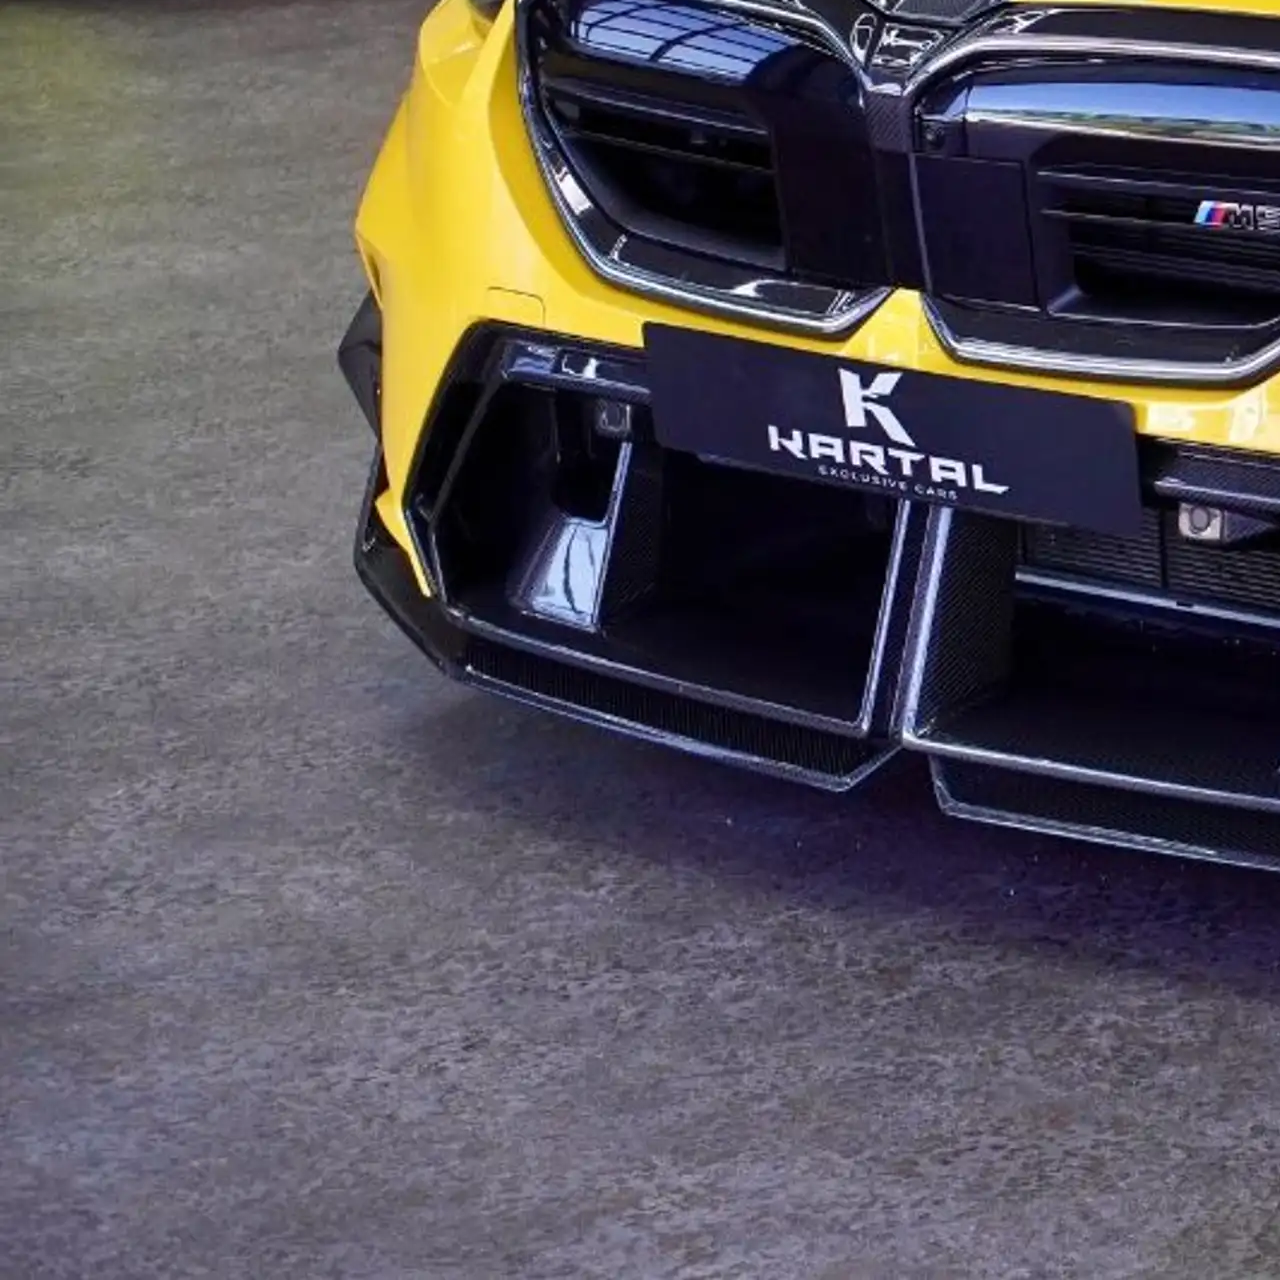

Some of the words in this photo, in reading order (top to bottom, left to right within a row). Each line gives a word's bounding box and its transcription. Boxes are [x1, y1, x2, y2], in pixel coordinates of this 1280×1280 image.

[837, 367, 917, 448] K
[767, 424, 1010, 495] KARTAL
[818, 464, 908, 491] EXCLUSIVE
[913, 482, 959, 501] CARS
